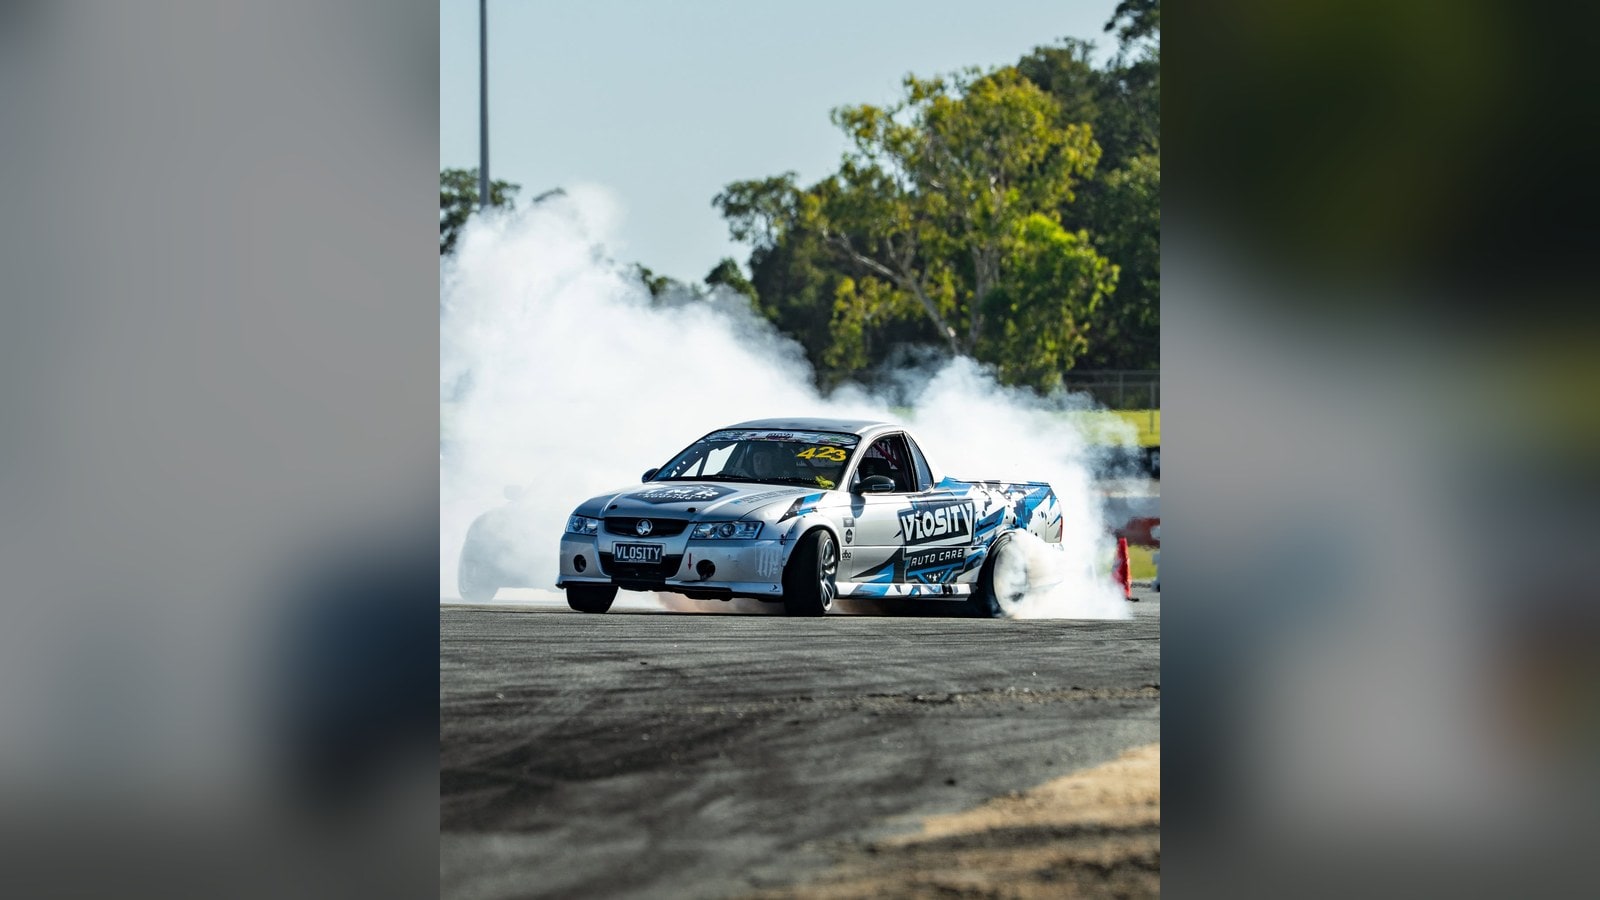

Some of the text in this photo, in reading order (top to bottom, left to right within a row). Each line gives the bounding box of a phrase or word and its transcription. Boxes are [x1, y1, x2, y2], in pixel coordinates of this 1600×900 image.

[796, 446, 847, 462] 423
[901, 502, 974, 542] VLOSITY
[616, 546, 661, 560] VLOSITY
[911, 548, 963, 566] AUTO CARE
